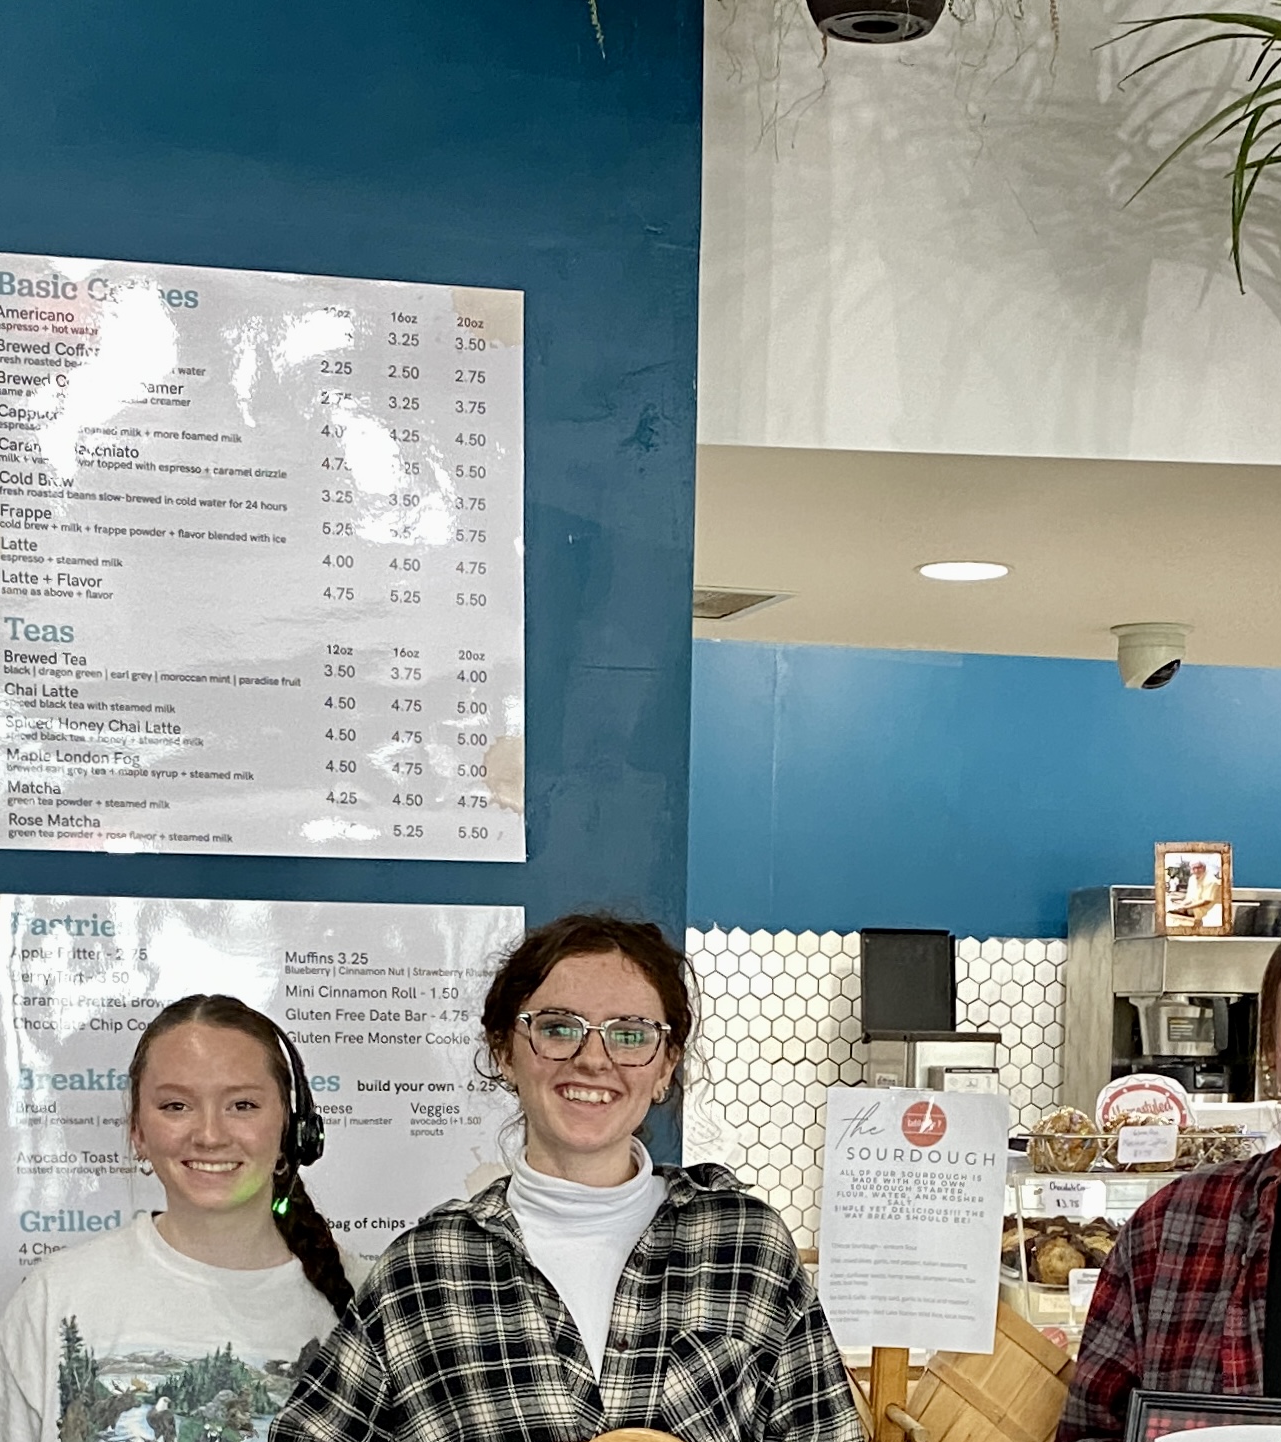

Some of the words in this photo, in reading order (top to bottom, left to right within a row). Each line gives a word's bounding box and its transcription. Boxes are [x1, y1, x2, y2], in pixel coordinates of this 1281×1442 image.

[391, 312, 418, 324] 16oz
[457, 316, 484, 329] 20oz
[388, 332, 419, 347] 3.25
[455, 337, 486, 352] 3.50
[320, 360, 352, 375] 2.25
[388, 365, 420, 380] 2.50
[455, 369, 486, 384] 2.75
[388, 396, 420, 411] 3.25
[455, 400, 486, 415] 3.75
[0, 471, 33, 486] Cold
[0, 503, 52, 520] Frappe
[1, 536, 38, 552] Latte
[322, 554, 354, 568] 4.00
[389, 558, 421, 572] 4.50
[455, 561, 487, 575] 4.75
[2, 569, 39, 585] Latte
[42, 574, 52, 584] +
[57, 573, 103, 588] Flavor
[323, 586, 354, 601] 4.75
[390, 589, 421, 604] 5.25
[456, 593, 487, 607] 5.50
[4, 616, 74, 643] Teas
[4, 649, 57, 665] Brewed
[62, 652, 87, 666] Tea
[326, 644, 353, 656] 12oz
[393, 647, 420, 658] 16oz
[458, 650, 485, 661] 20oz
[324, 664, 356, 678] 3.50
[390, 667, 422, 681] 3.75
[457, 670, 487, 683] 4.00
[4, 682, 37, 696] Chai
[42, 684, 79, 698] Latte
[324, 696, 356, 710] 4.50
[391, 699, 422, 712] 4.75
[457, 701, 487, 715] 5.00
[6, 747, 50, 762] Maple
[56, 749, 109, 764] London
[113, 751, 140, 769] Fog
[325, 760, 357, 773] 4.50
[392, 762, 423, 775] 4.75
[457, 764, 487, 777] 5.00
[8, 780, 61, 795] Matcha
[8, 812, 43, 826] Rose
[47, 814, 101, 828] Matcha
[393, 824, 424, 838] 5.25
[458, 826, 488, 839] 5.50
[285, 951, 334, 964] Muffins
[337, 952, 369, 965] 3.25
[286, 985, 314, 997] Mini
[318, 985, 387, 999] Cinnamon
[392, 986, 417, 999] Roll
[430, 987, 459, 1000] 1.50
[285, 1008, 331, 1021] Gluten
[335, 1008, 366, 1022] Free
[370, 1009, 400, 1022] Date
[405, 1009, 427, 1022] Bar
[439, 1009, 469, 1022] 4.75
[357, 1080, 390, 1092] build
[394, 1083, 425, 1095] your
[427, 1083, 455, 1092] own
[466, 1080, 497, 1092] 6.25
[410, 1102, 460, 1118] Veggies
[835, 1101, 885, 1150] the
[846, 1147, 996, 1166] SOURDOUGH
[20, 1209, 121, 1233] Grilled
[327, 1218, 351, 1232] bag
[354, 1217, 368, 1229] of
[371, 1217, 406, 1231] chips
